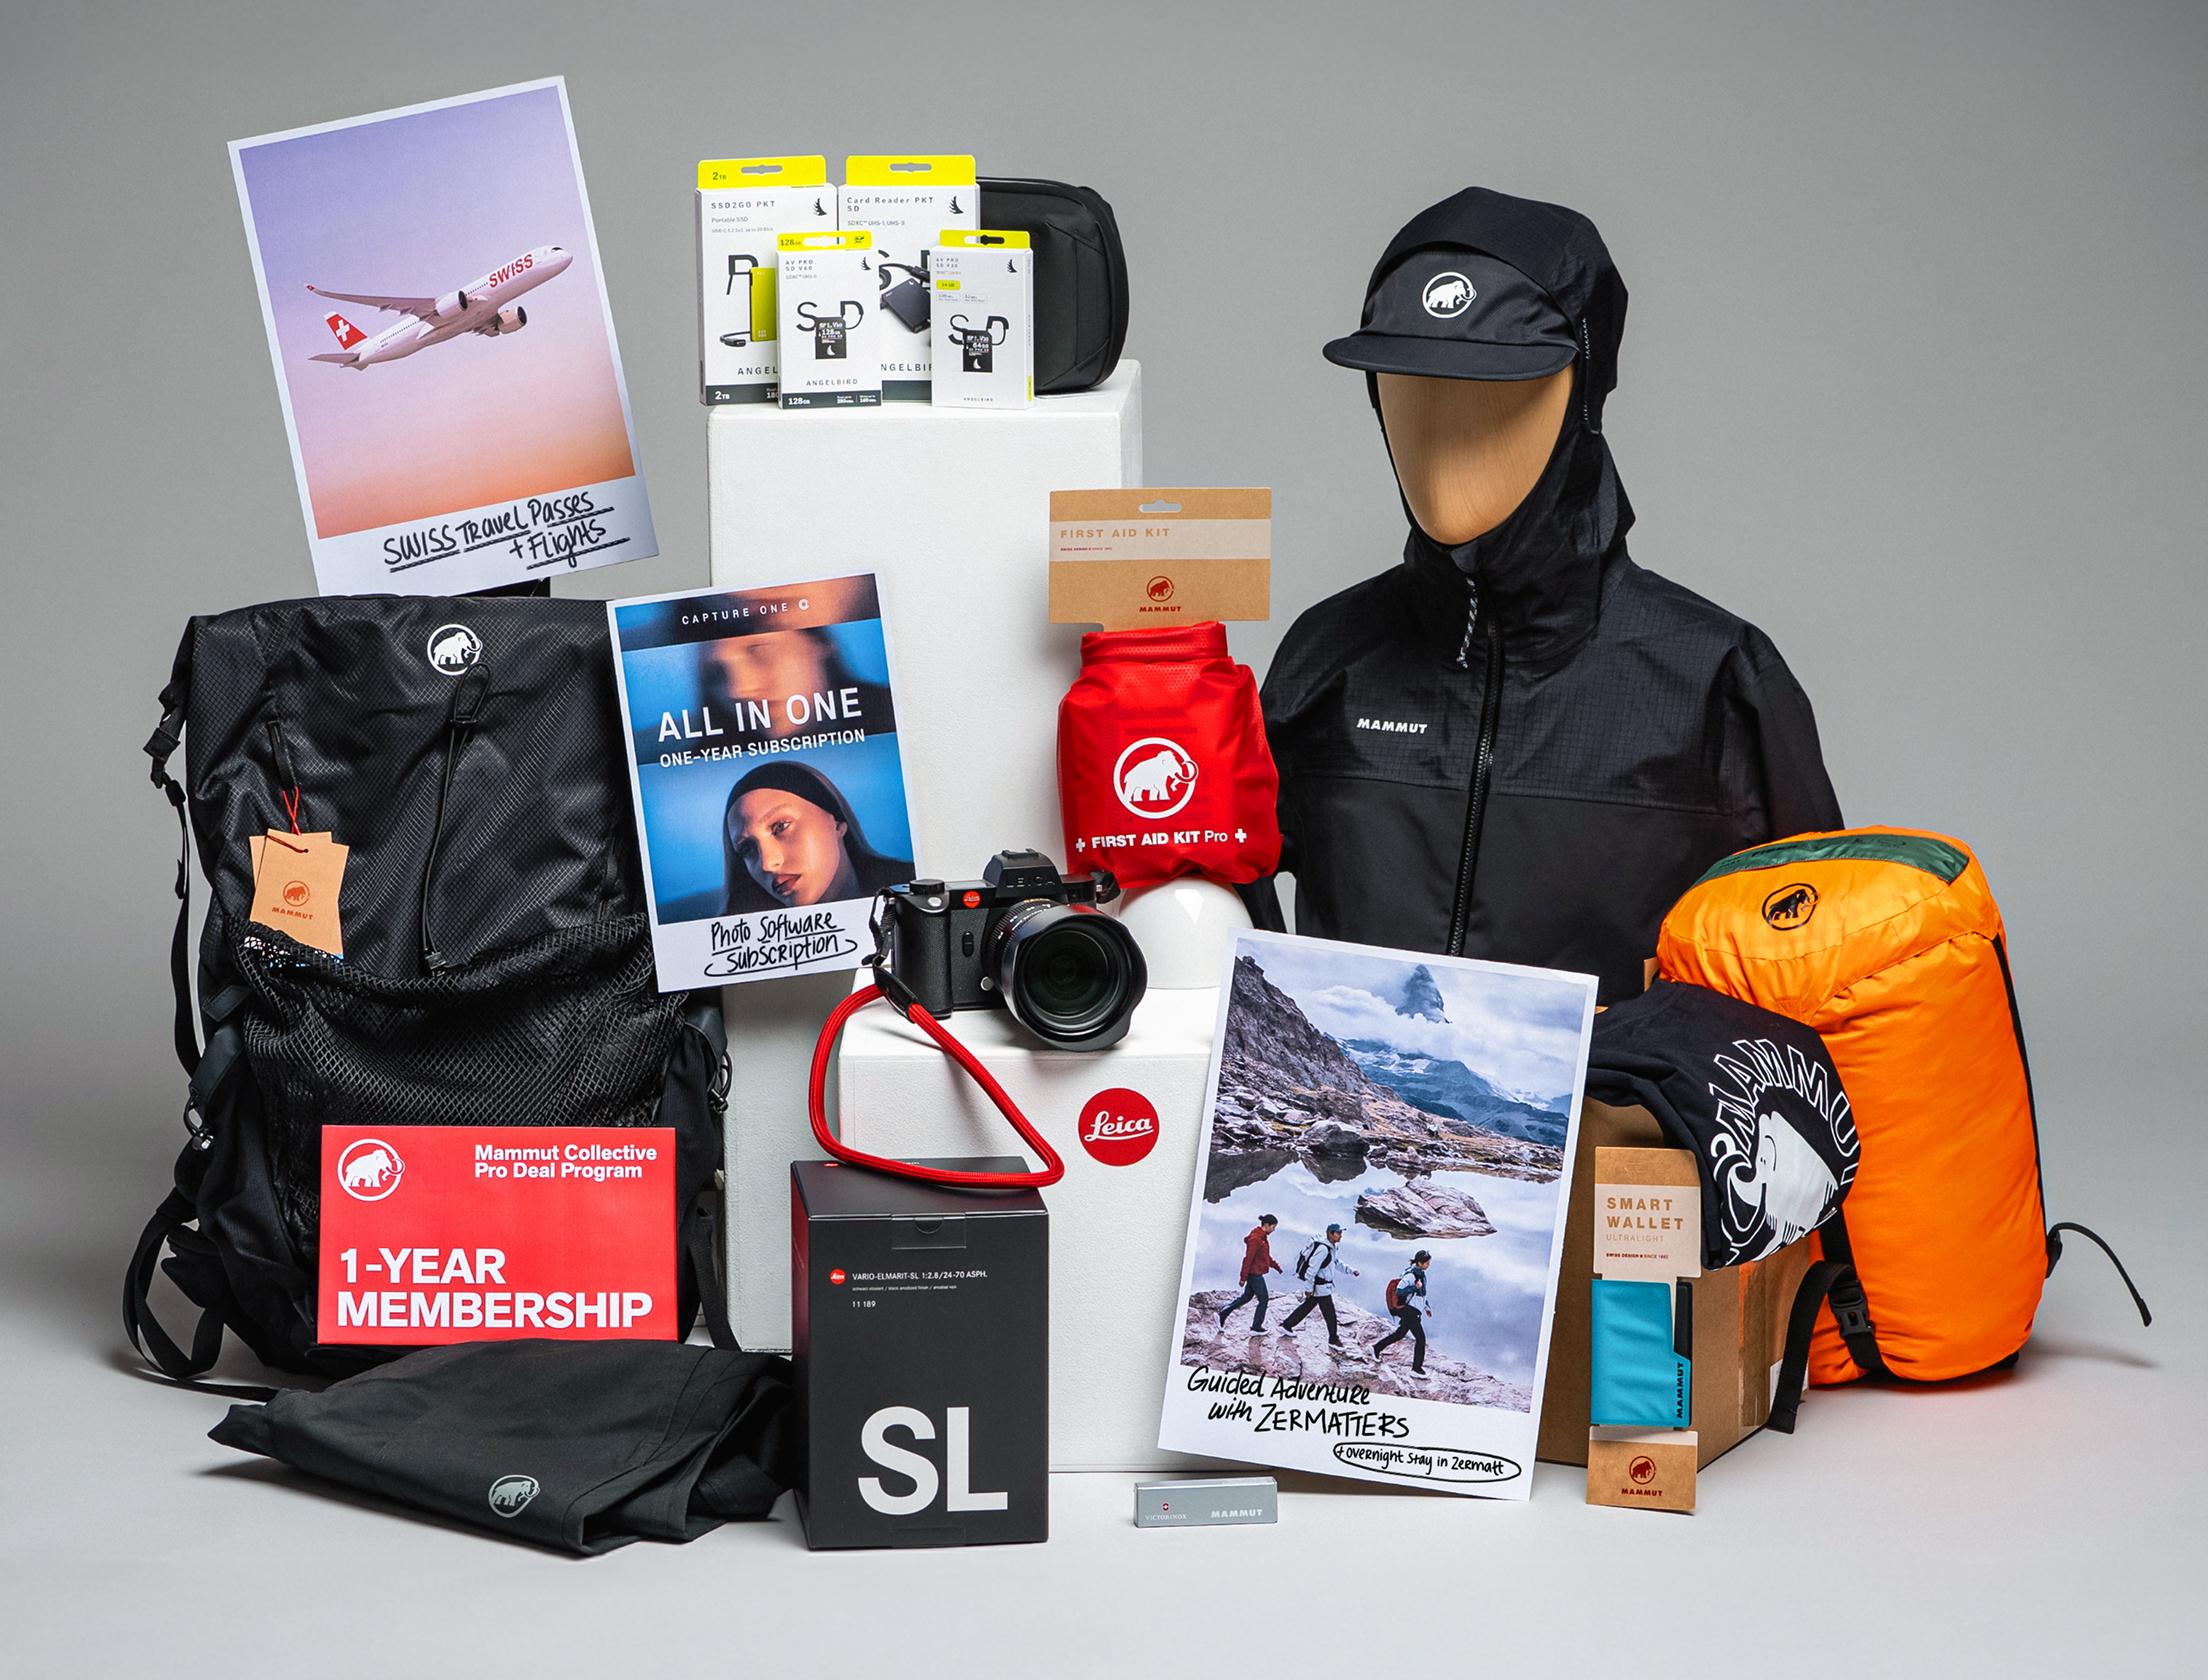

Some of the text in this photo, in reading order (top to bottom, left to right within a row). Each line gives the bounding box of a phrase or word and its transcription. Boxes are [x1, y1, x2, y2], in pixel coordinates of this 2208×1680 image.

[488, 254, 534, 288] SWISS
[715, 392, 730, 400] 2TB
[384, 524, 457, 565] SWISS
[528, 492, 594, 526] Passes
[1060, 528, 1170, 538] FIRST AID KIT
[682, 602, 789, 625] CAPTURE ONE
[658, 687, 862, 742] ALL IN ONE
[1356, 718, 1428, 734] MAMMUT
[660, 728, 865, 768] ONE-YEAR SUBSCRIPTION
[1092, 830, 1228, 848] FIRST AID KIT Pro
[272, 907, 314, 920] MAMMUT
[1084, 1111, 1154, 1142] Leica
[475, 1144, 657, 1161] Mammut Collective
[475, 1162, 642, 1182] Pro Deal Program
[1607, 1197, 1672, 1211] SMART
[1606, 1216, 1683, 1230] WALLET
[1606, 1234, 1664, 1242] ULTRALIGHT
[341, 1248, 506, 1284] 1-YEAR
[852, 1270, 987, 1280] VARIO-ELMARIT-SL 1:2.8/24-70 ASPH.
[337, 1292, 653, 1329] MEMBERSHIP
[1187, 1366, 1265, 1398] Guided
[1207, 1398, 1410, 1438] with ZERMATTERS
[858, 1406, 1008, 1515] SL
[1437, 1456, 1448, 1468] in
[1621, 1488, 1663, 1497] MAMMUT
[1210, 1509, 1263, 1518] MAMMUT
